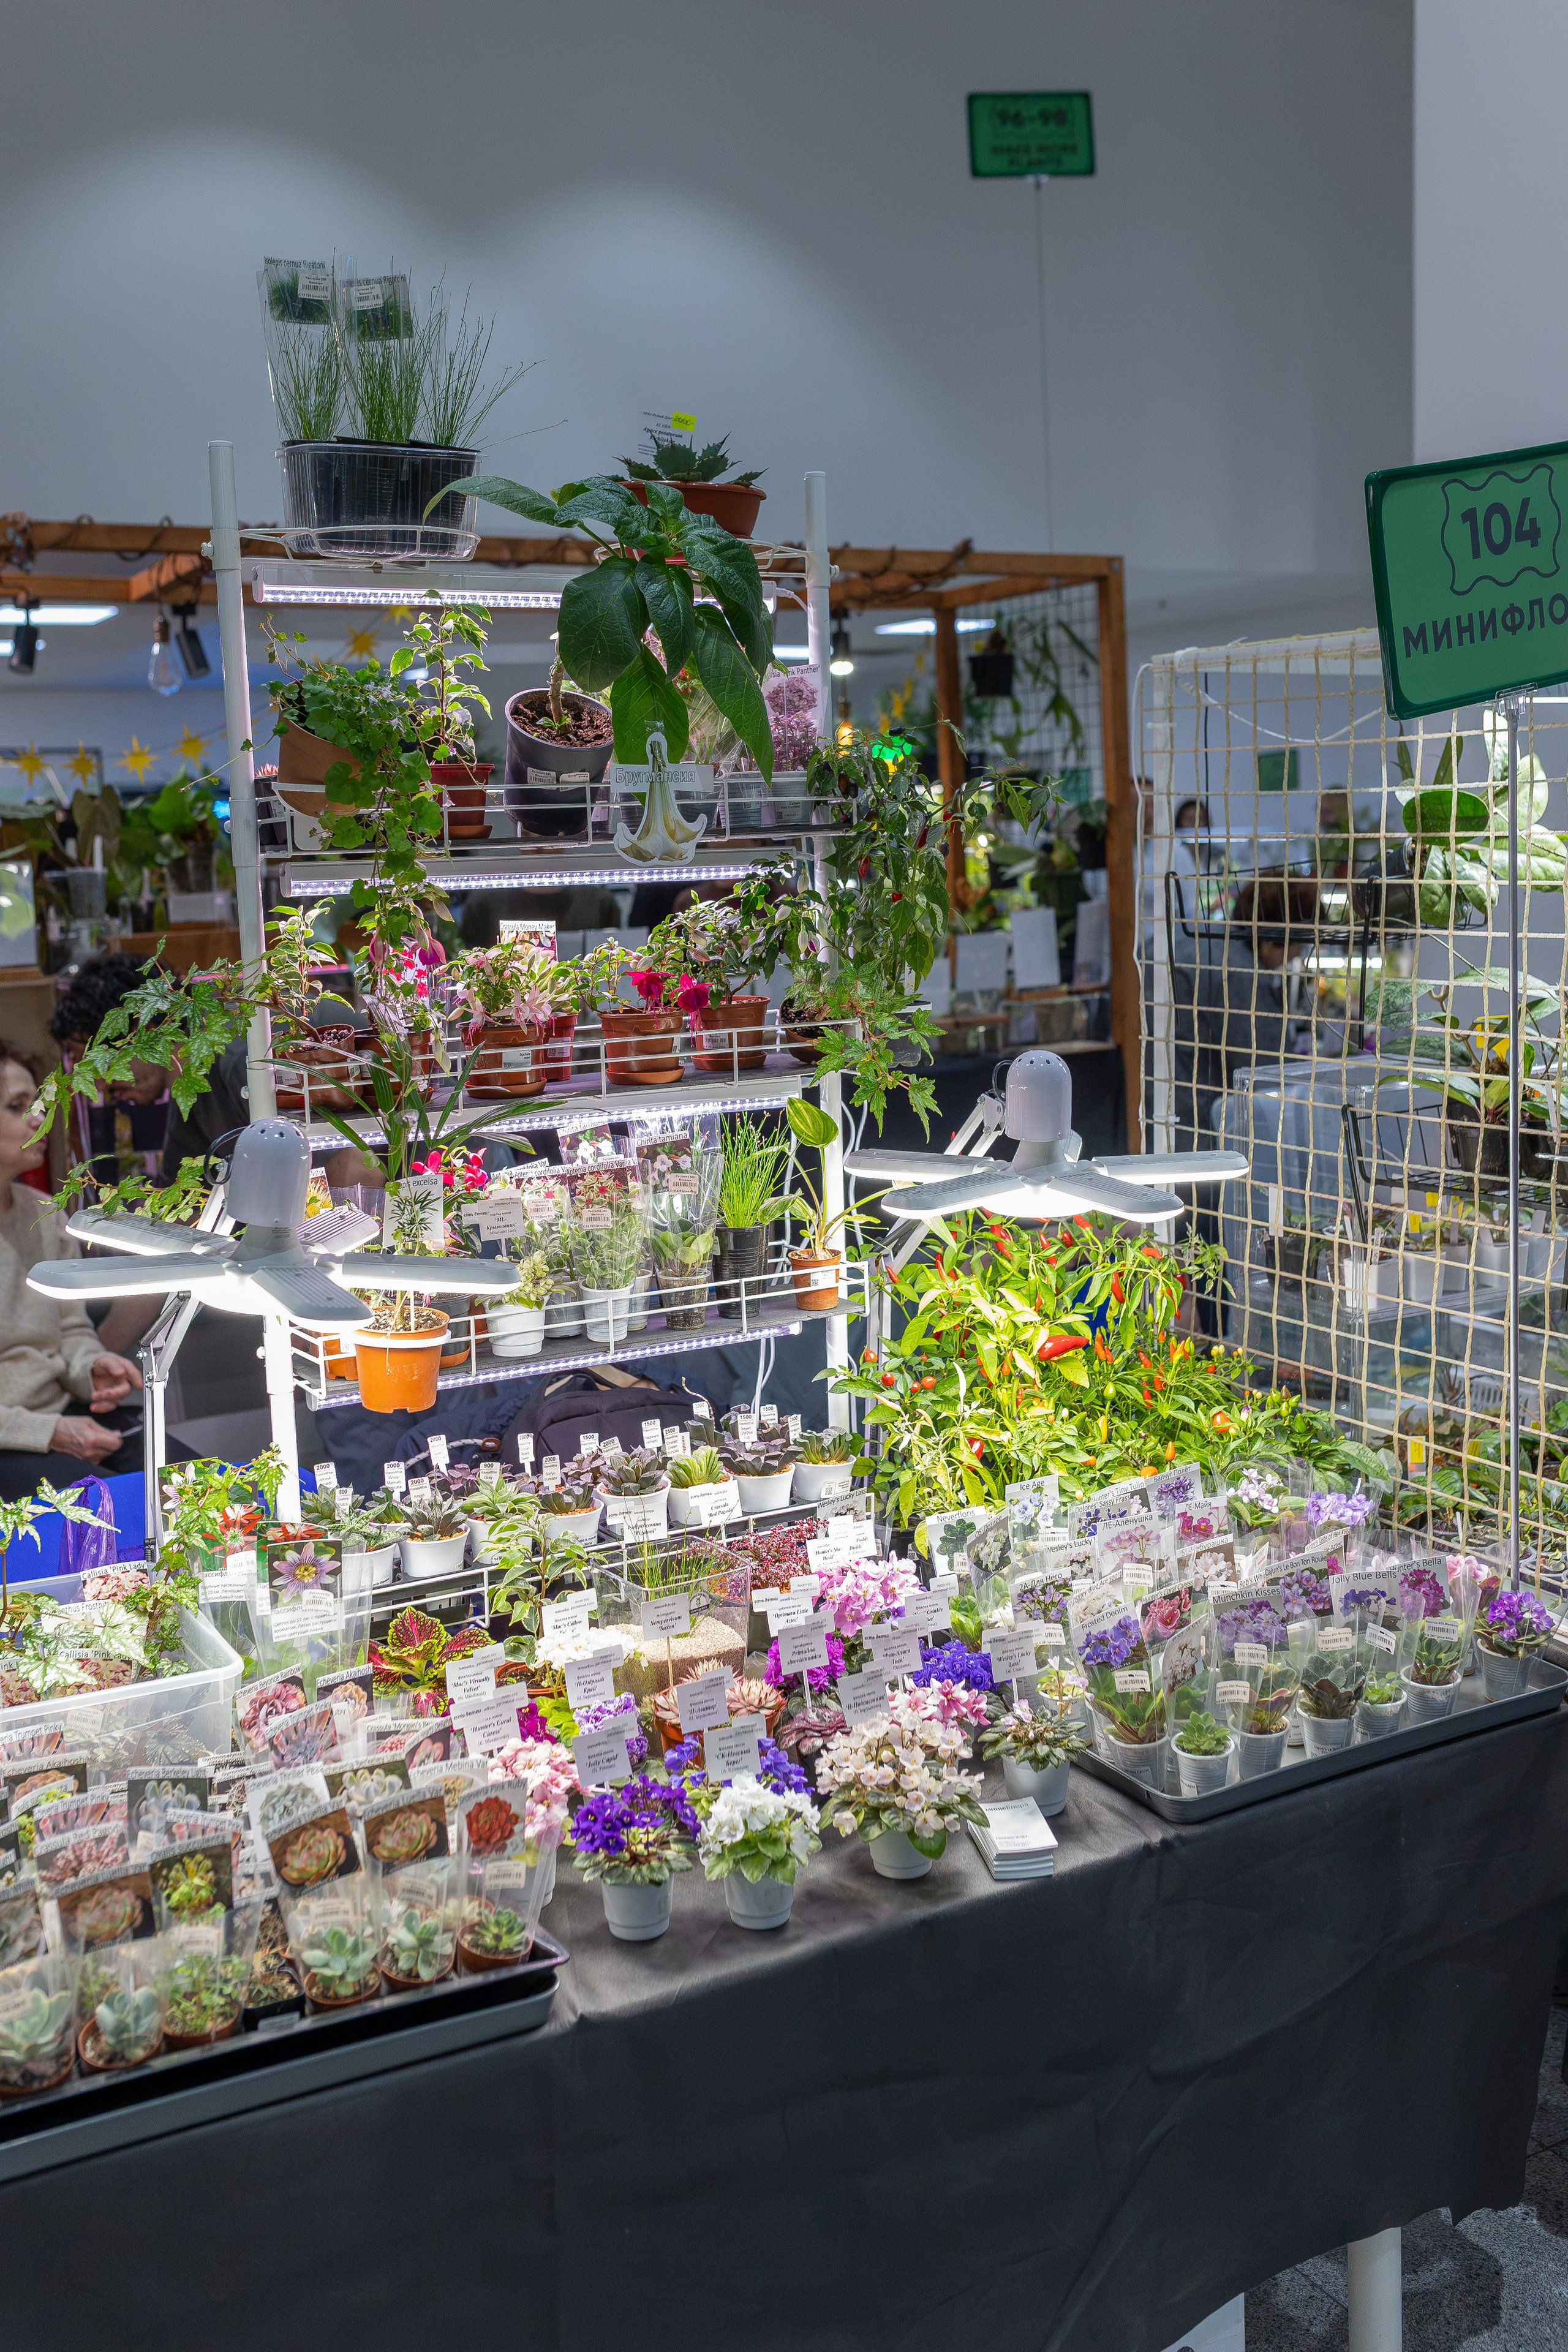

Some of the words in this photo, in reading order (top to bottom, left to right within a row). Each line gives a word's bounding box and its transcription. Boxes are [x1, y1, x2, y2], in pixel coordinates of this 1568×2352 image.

[264, 256, 282, 267] Isolepis
[303, 260, 325, 271] Rigatoni
[1461, 497, 1542, 559] 104
[797, 665, 820, 675] Panther'
[615, 768, 695, 784] Бругмансия
[659, 1133, 687, 1143] tamiana
[534, 1166, 559, 1175] cordifolia
[567, 1167, 586, 1176] Aptenia
[587, 1162, 614, 1172] cordifolia
[412, 1177, 437, 1186] excelsa
[486, 1222, 517, 1231] Крыжовник'
[603, 1445, 619, 1453] Haworthia
[1153, 1472, 1172, 1483] Балчуг
[1173, 1466, 1191, 1477] Полёт
[1030, 1479, 1046, 1491] Age
[1115, 1485, 1128, 1497] Tiny
[1128, 1480, 1145, 1493] Tulip
[817, 1498, 840, 1509] Wesley's
[840, 1493, 855, 1502] Lucky
[1075, 1504, 1099, 1514] Dolores'
[1099, 1498, 1115, 1508] Sassy
[1185, 1501, 1212, 1512] ЛЕ-Майя
[717, 1507, 734, 1517] Pagoda'
[937, 1509, 976, 1523] Neverfloris
[1102, 1514, 1153, 1531] ЛЕ-Алёнушка
[1074, 1538, 1093, 1548] Lucky
[1181, 1537, 1228, 1556] SL-Чебурашка
[1317, 1536, 1328, 1544] Taste
[1330, 1541, 1343, 1551] Aztec
[82, 1569, 108, 1580] Callisia
[110, 1563, 127, 1572] 'Pink
[1265, 1565, 1282, 1577] Cajun's
[1290, 1560, 1300, 1569] Bon
[1389, 1562, 1421, 1573] Hunter's
[1422, 1558, 1442, 1567] Bella
[1046, 1572, 1063, 1583] Hero
[1088, 1583, 1099, 1594] Blue
[1099, 1578, 1109, 1587] Ace
[1109, 1571, 1123, 1581] sport
[1239, 1575, 1253, 1589] Rob's
[1331, 1574, 1352, 1585] Jolly
[1352, 1572, 1373, 1581] Blue
[1376, 1570, 1397, 1580] Bells
[1163, 1586, 1177, 1597] Coral
[1177, 1581, 1194, 1591] Caress
[1213, 1589, 1253, 1605] Munchkin
[1255, 1588, 1281, 1597] Kisses
[650, 1615, 682, 1627] Sempervivum
[1081, 1614, 1106, 1631] Frosted
[1106, 1605, 1129, 1620] Denim
[658, 1623, 677, 1632] 'Saxon'
[91, 1650, 110, 1659] 'Pink
[792, 1648, 815, 1656] Primulina
[997, 1653, 1017, 1662] 'Wesley's
[787, 1654, 821, 1665] sinovietnamica
[235, 1683, 259, 1699] Echeveria
[279, 1665, 301, 1679] Rainbow
[317, 1674, 344, 1687] Echeveria
[345, 1665, 373, 1680] Akaihoshi
[451, 1679, 468, 1688] 'Mac's
[469, 1676, 491, 1685] Virtually
[470, 1722, 496, 1732] 'Hunter's
[496, 1717, 511, 1725] Coral
[14, 1726, 43, 1741] Trumpet
[483, 1728, 502, 1738] Caress'
[2, 1763, 43, 1777] Echeveria
[45, 1755, 86, 1769] Akaihoshi
[586, 1759, 600, 1769] 'Jolly
[601, 1754, 619, 1765] Cupid'
[59, 1797, 88, 1809] Trumpet
[34, 1836, 70, 1855] Crassula
